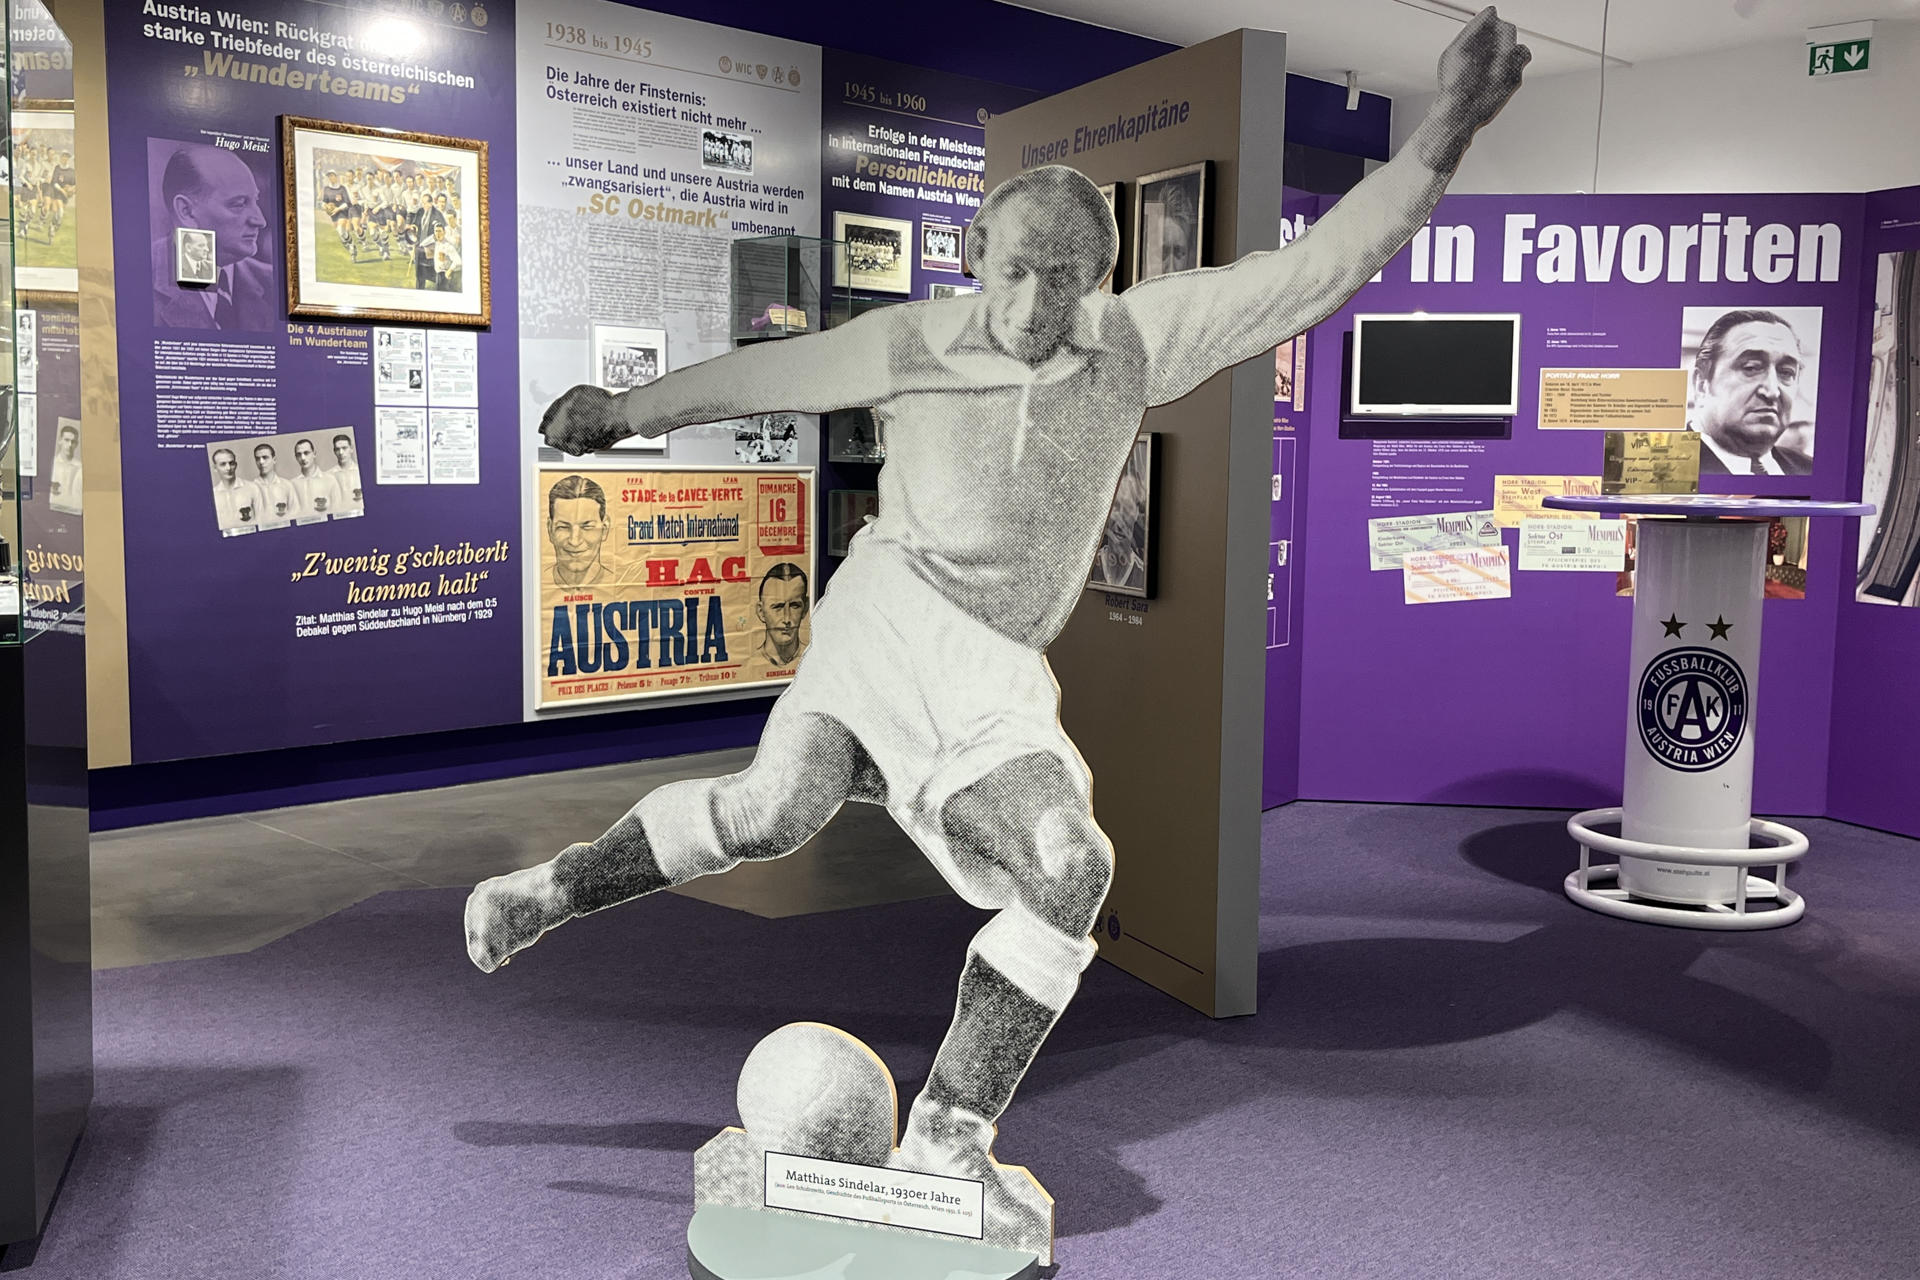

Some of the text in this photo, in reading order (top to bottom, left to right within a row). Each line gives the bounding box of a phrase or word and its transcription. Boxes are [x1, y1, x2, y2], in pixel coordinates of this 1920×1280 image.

[143, 0, 212, 26] Austria
[217, 10, 269, 35] Wien:
[275, 19, 355, 52] Rückgrat
[545, 22, 652, 58] 1938 bis 1945
[143, 22, 205, 46] starke
[211, 31, 301, 61] Triebfeder
[306, 47, 336, 67] des
[342, 51, 475, 90] österreichischen
[546, 65, 706, 107] Die Jahre der Finsternis:
[844, 81, 926, 112] 1945 bis 1960
[546, 81, 617, 110] Österreich
[622, 100, 677, 120] existiert
[681, 108, 712, 127] nicht
[716, 115, 747, 131] mehr
[215, 136, 270, 153] Hugo Meisl:
[868, 124, 905, 145] Erfolge
[908, 131, 917, 145] in
[920, 134, 936, 149] der
[1021, 98, 1190, 169] Unsere Ehrenkapitäne
[829, 134, 839, 148] in
[842, 135, 920, 162] internationalen
[565, 155, 603, 171] unser
[607, 159, 639, 177] Land
[643, 166, 666, 181] und
[670, 170, 712, 187] unsere
[716, 175, 759, 195] Austria
[762, 184, 804, 201] werden
[832, 175, 981, 208] mit dem Namen Austria Wien
[680, 187, 699, 202] die
[703, 190, 746, 209] Austria
[750, 197, 774, 213] wird
[778, 200, 788, 214] in
[731, 219, 796, 236] umbenannt
[1410, 213, 1842, 284] in Favoriten
[288, 323, 368, 338] Die 4 Austrianer
[304, 336, 368, 349] Wunderteam
[622, 489, 657, 503] STADE
[659, 491, 668, 502] de
[669, 491, 675, 502] la
[760, 483, 796, 494] DIMANCHE
[1521, 487, 1541, 495] West
[769, 498, 786, 522] 16
[628, 513, 739, 540] Grand Match International
[760, 524, 797, 537] DÉCEMBRE
[1549, 531, 1563, 539] Ost
[347, 580, 431, 605] hamma
[684, 588, 715, 596] CONTRE
[1105, 593, 1149, 613] Robert Sara
[295, 597, 498, 626] Zitat: Matthias Sindelar zu Hugo Meisl nach dem 0:5
[296, 624, 329, 638] Debakel
[332, 622, 357, 637] gegen
[359, 616, 421, 632] Süddeutschland
[423, 614, 430, 625] in
[432, 611, 467, 625] Nürnberg
[474, 608, 493, 620] 1929
[1109, 611, 1123, 622] 1964
[547, 596, 729, 677] AUSTRIA
[574, 684, 585, 695] DES
[721, 671, 730, 680] 10
[1650, 656, 1740, 694] FUSSBALLKLUB
[1643, 698, 1653, 711] 19
[1733, 704, 1742, 716] 11
[1647, 726, 1735, 763] AUSTRIA WIEN
[786, 1169, 961, 1206] Matthias Sindelar, 1930er Jahre
